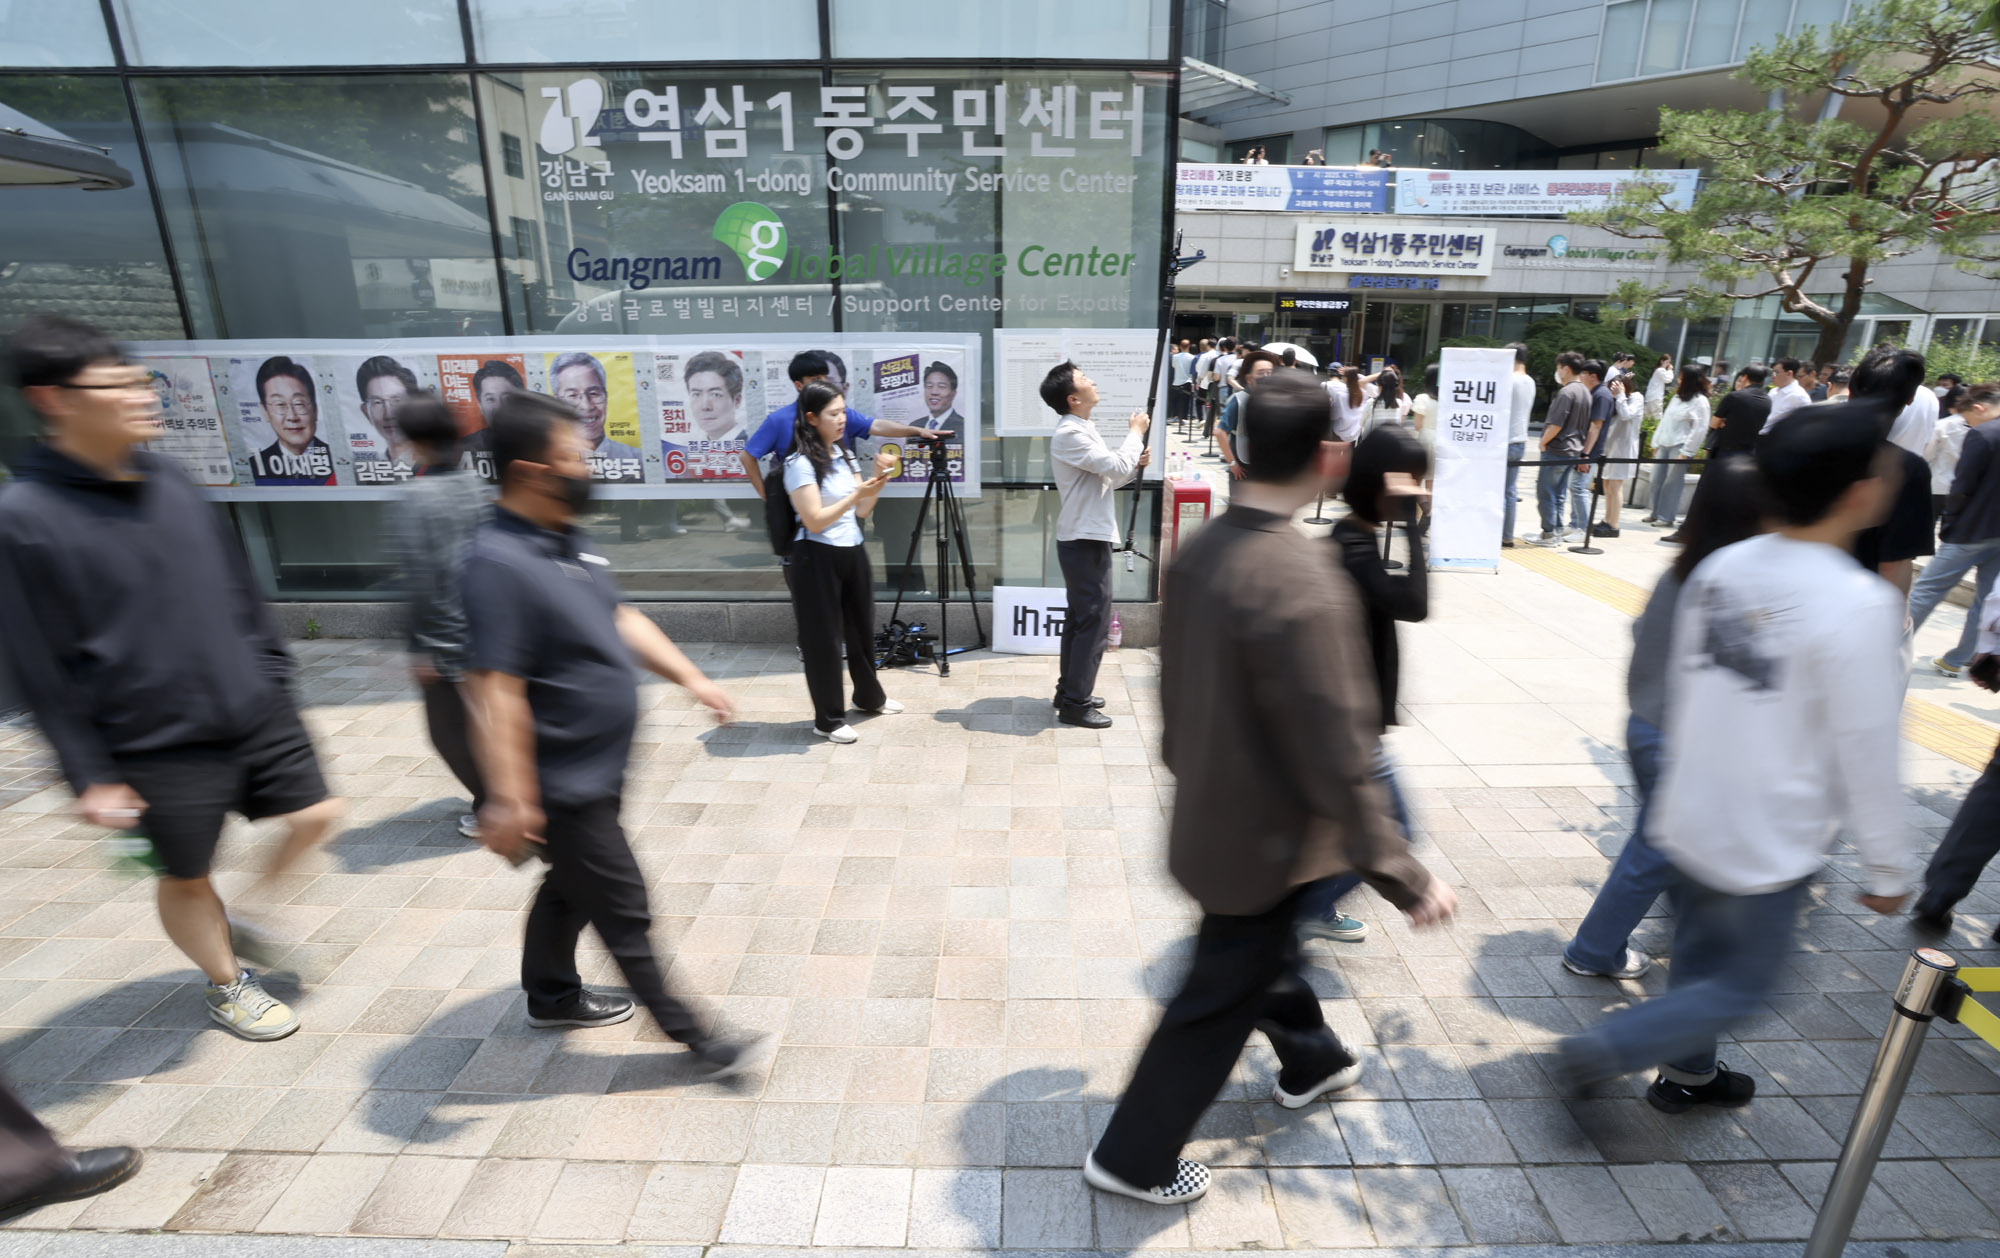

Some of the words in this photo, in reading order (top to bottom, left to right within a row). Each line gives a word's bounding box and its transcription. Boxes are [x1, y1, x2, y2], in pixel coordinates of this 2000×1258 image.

[624, 84, 1145, 161] 역삼1동주민센터
[540, 160, 615, 188] 강남구
[630, 169, 726, 194] Yeoksam
[734, 167, 812, 196] 1-dong
[827, 166, 957, 196] Community
[965, 166, 1050, 192] Service
[1059, 167, 1138, 193] Center
[599, 190, 614, 200] GU
[1247, 187, 1282, 198] 드립니다
[1430, 182, 1452, 196] 세탁
[1482, 183, 1505, 196] 보관
[1507, 183, 1541, 196] 서비스
[1341, 231, 1484, 257] 역삼1동주민센터
[567, 247, 722, 291] Gangnam
[886, 243, 1008, 287] Village
[1017, 244, 1136, 277] Center
[1340, 258, 1368, 267] Yeoksam
[1370, 258, 1393, 268] 1-dong
[1395, 258, 1431, 270] Community
[1432, 260, 1456, 269] Service
[1457, 261, 1479, 270] Center
[571, 295, 814, 322] 강남글로벌빌리지센터
[844, 294, 931, 316] Support
[938, 293, 1011, 313] Center
[1019, 294, 1048, 312] for
[1055, 294, 1130, 315] Expats
[440, 359, 479, 374] 미래를
[443, 374, 470, 388] 여는
[445, 388, 473, 403] 선택
[1452, 380, 1497, 405] 관내
[186, 417, 218, 431] 주의문
[662, 408, 686, 421] 정치
[1449, 412, 1494, 430] 선거인
[663, 422, 692, 434] 교체!
[268, 453, 333, 477] 이재명
[354, 460, 414, 482] 김문수
[584, 457, 641, 480] 권영국
[665, 450, 686, 475] 6
